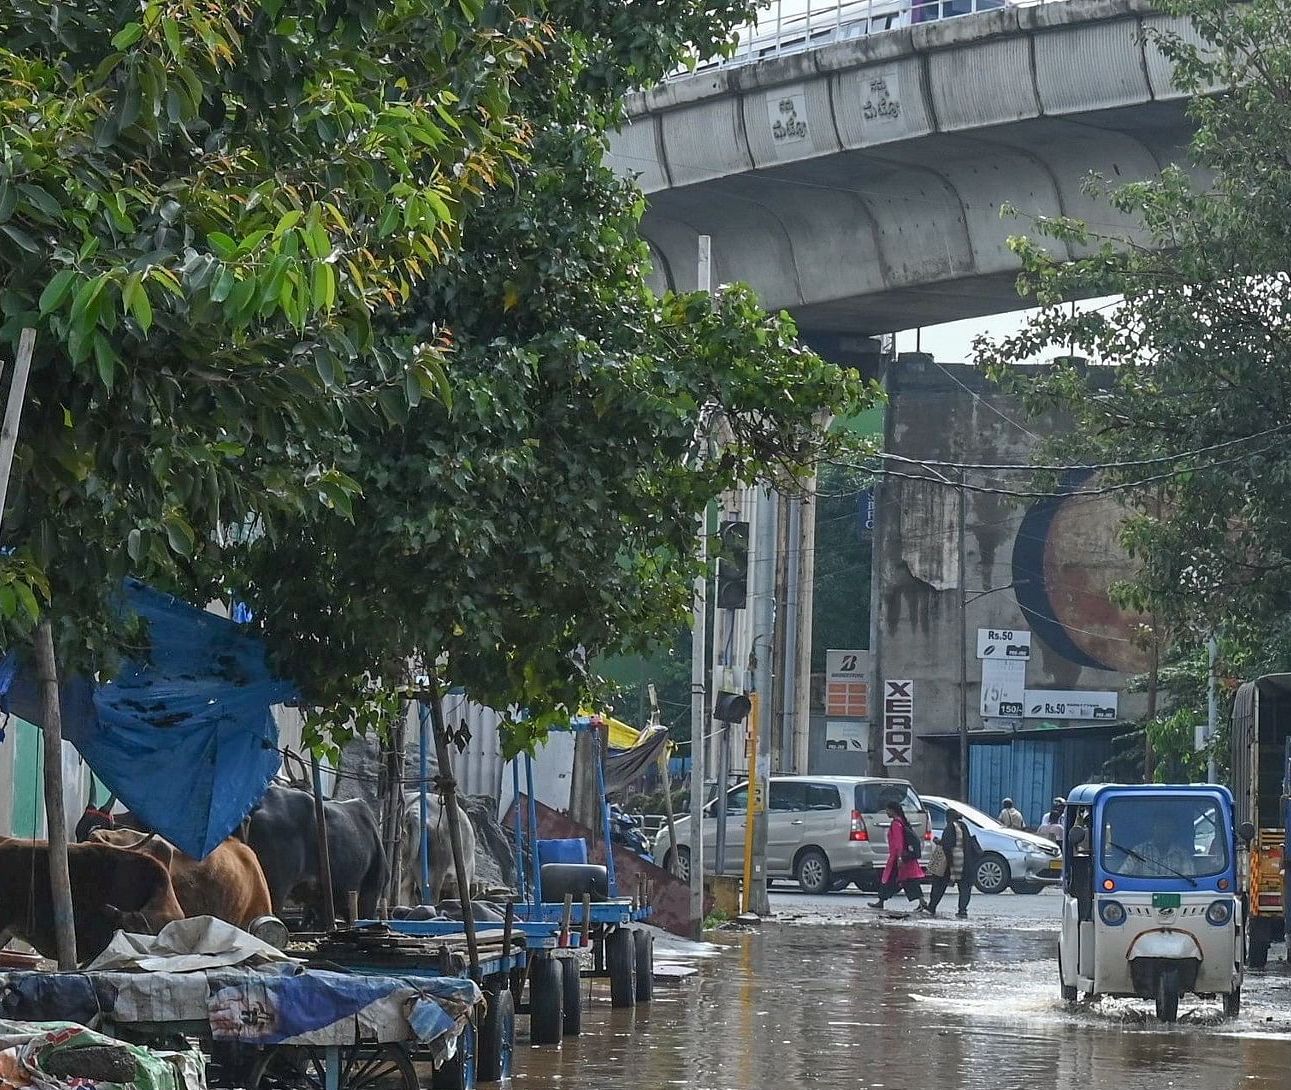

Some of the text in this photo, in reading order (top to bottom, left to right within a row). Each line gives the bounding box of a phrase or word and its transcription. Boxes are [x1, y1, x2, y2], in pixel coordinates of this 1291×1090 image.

[988, 630, 1013, 641] Rs.50
[1045, 703, 1066, 715] Rs.50
[885, 681, 912, 763] XEROX
